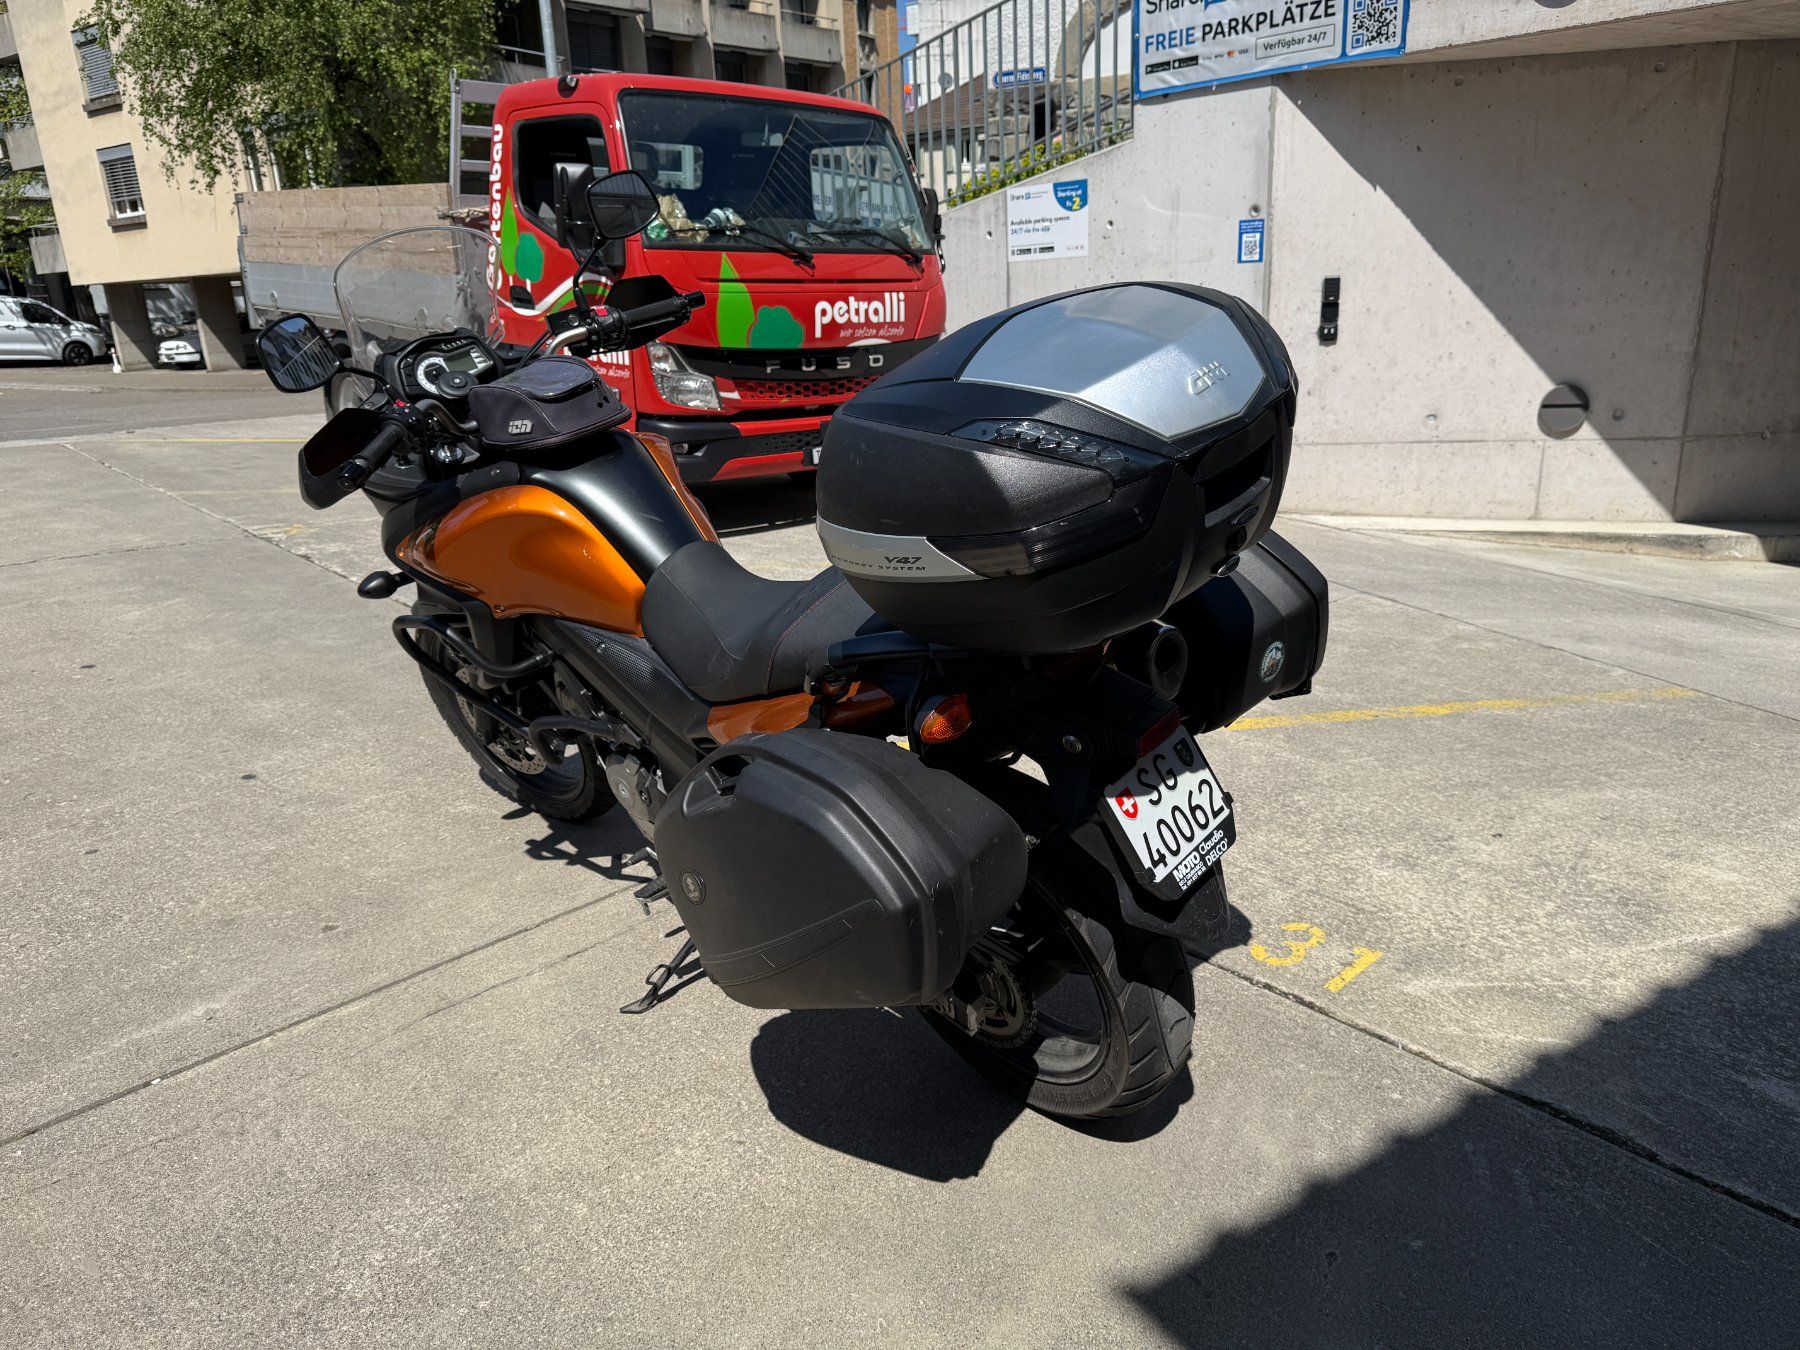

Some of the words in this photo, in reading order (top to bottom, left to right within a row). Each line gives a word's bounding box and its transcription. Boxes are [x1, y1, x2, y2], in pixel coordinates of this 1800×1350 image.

[1145, 25, 1196, 53] FREIE
[1201, 0, 1336, 42] PARKPLÄTZE
[1263, 35, 1305, 52] Verfügbar
[1307, 31, 1328, 44] 24/7
[814, 291, 906, 339] petralli
[765, 354, 884, 374] FUSO
[884, 556, 922, 565] V47
[1136, 753, 1178, 805] SG
[1143, 779, 1225, 869] 40062
[1172, 851, 1200, 881] MOTO
[1199, 829, 1224, 855] Claudio
